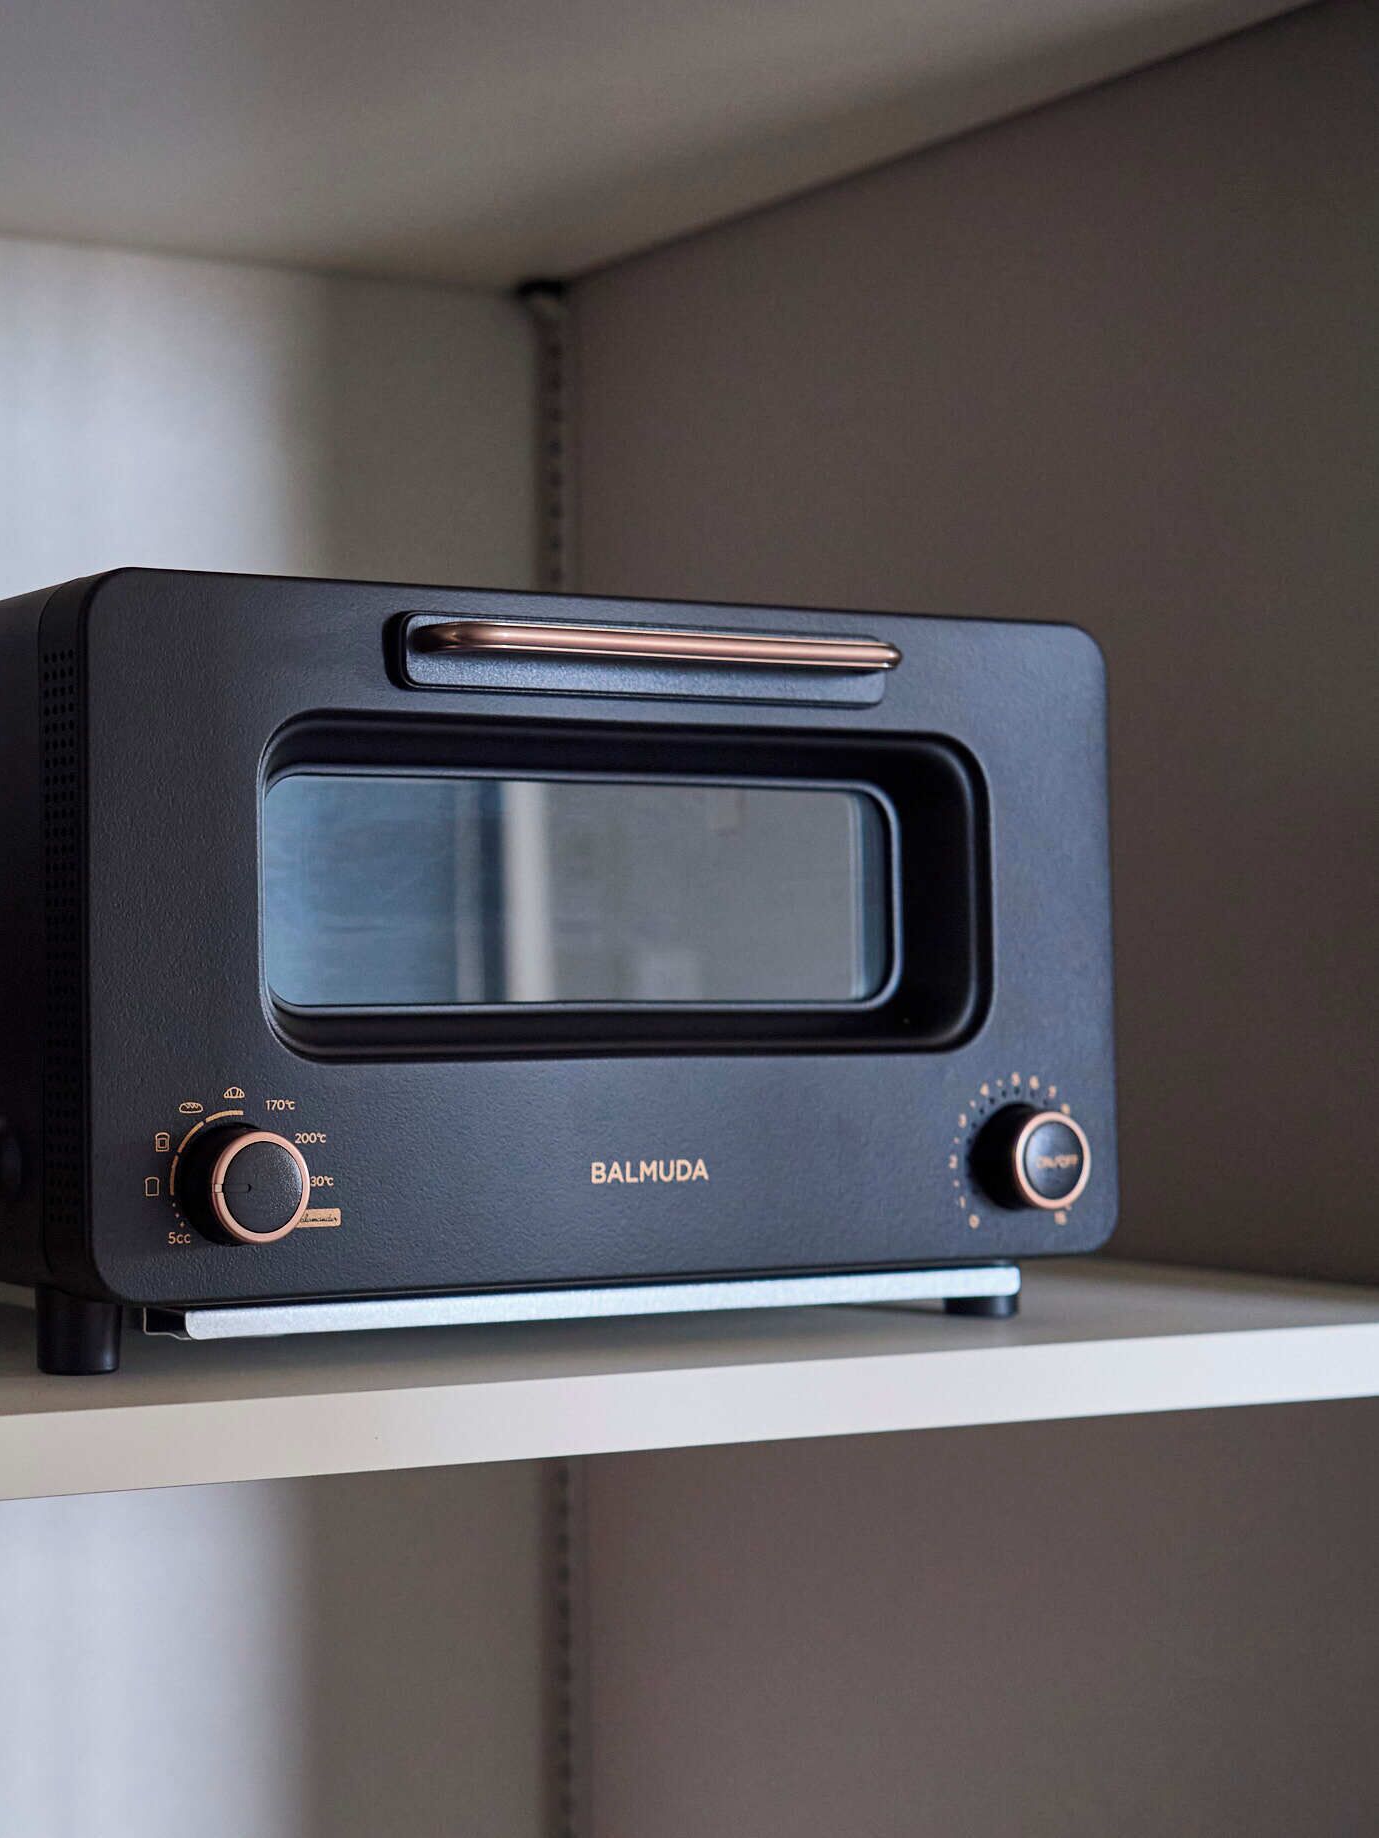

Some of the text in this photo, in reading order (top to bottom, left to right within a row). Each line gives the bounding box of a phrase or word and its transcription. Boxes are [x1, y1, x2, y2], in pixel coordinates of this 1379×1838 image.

[590, 1158, 710, 1184] BALMUDA
[309, 1175, 335, 1187] 30°C
[168, 1231, 191, 1245] 5cc
